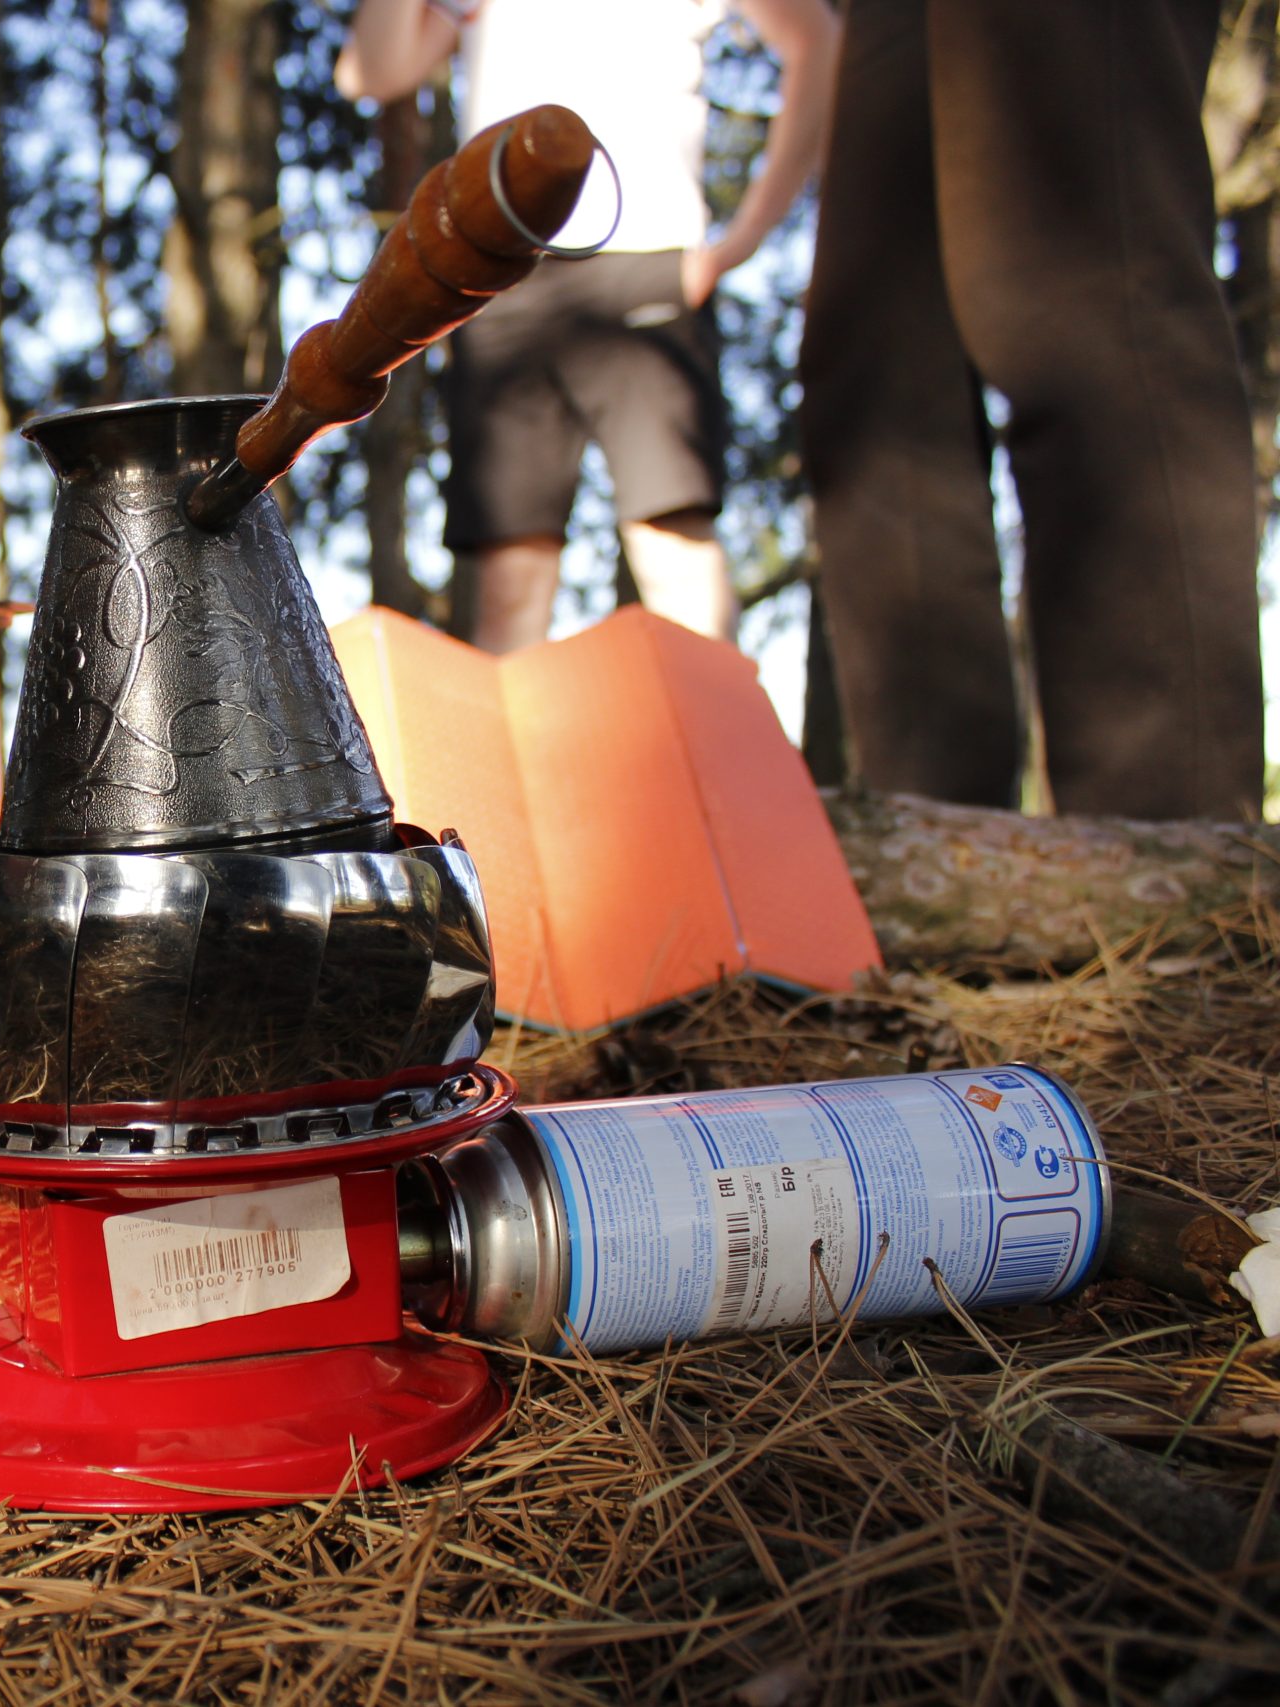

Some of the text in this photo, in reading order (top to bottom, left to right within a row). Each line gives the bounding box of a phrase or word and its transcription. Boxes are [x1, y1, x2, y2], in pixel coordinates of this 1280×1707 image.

[1032, 1099, 1057, 1129] EN417
[164, 1275, 226, 1296] 000000
[235, 1260, 297, 1283] 277905
